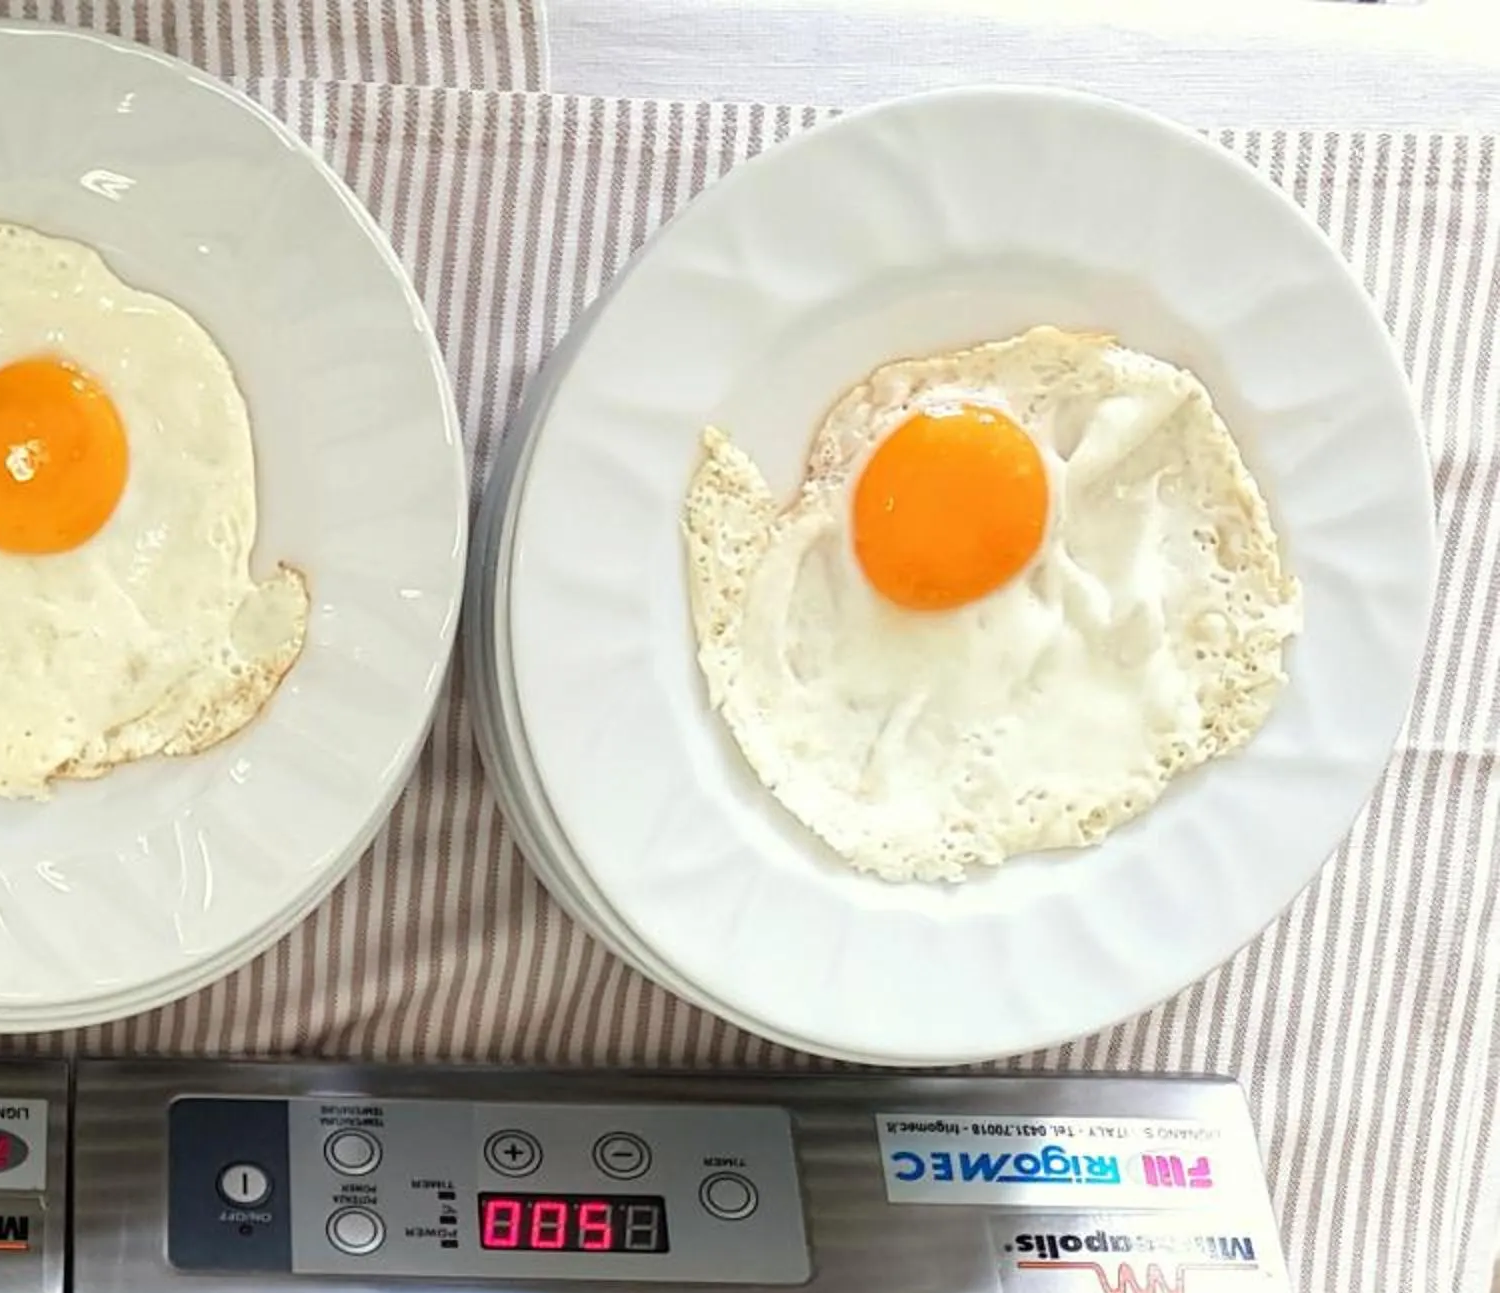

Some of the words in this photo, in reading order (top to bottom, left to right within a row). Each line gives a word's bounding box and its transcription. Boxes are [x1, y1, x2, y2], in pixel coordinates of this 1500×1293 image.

[886, 1120, 960, 1136] frigomec.it
[971, 1123, 1047, 1138] 0431.70018
[703, 1157, 747, 1168] TIMER
[341, 1185, 377, 1194] POWER
[411, 1180, 456, 1190] TIMER
[332, 1195, 378, 1205] POTENZA
[219, 1210, 272, 1222] ON/OFF
[405, 1227, 458, 1238] POWER
